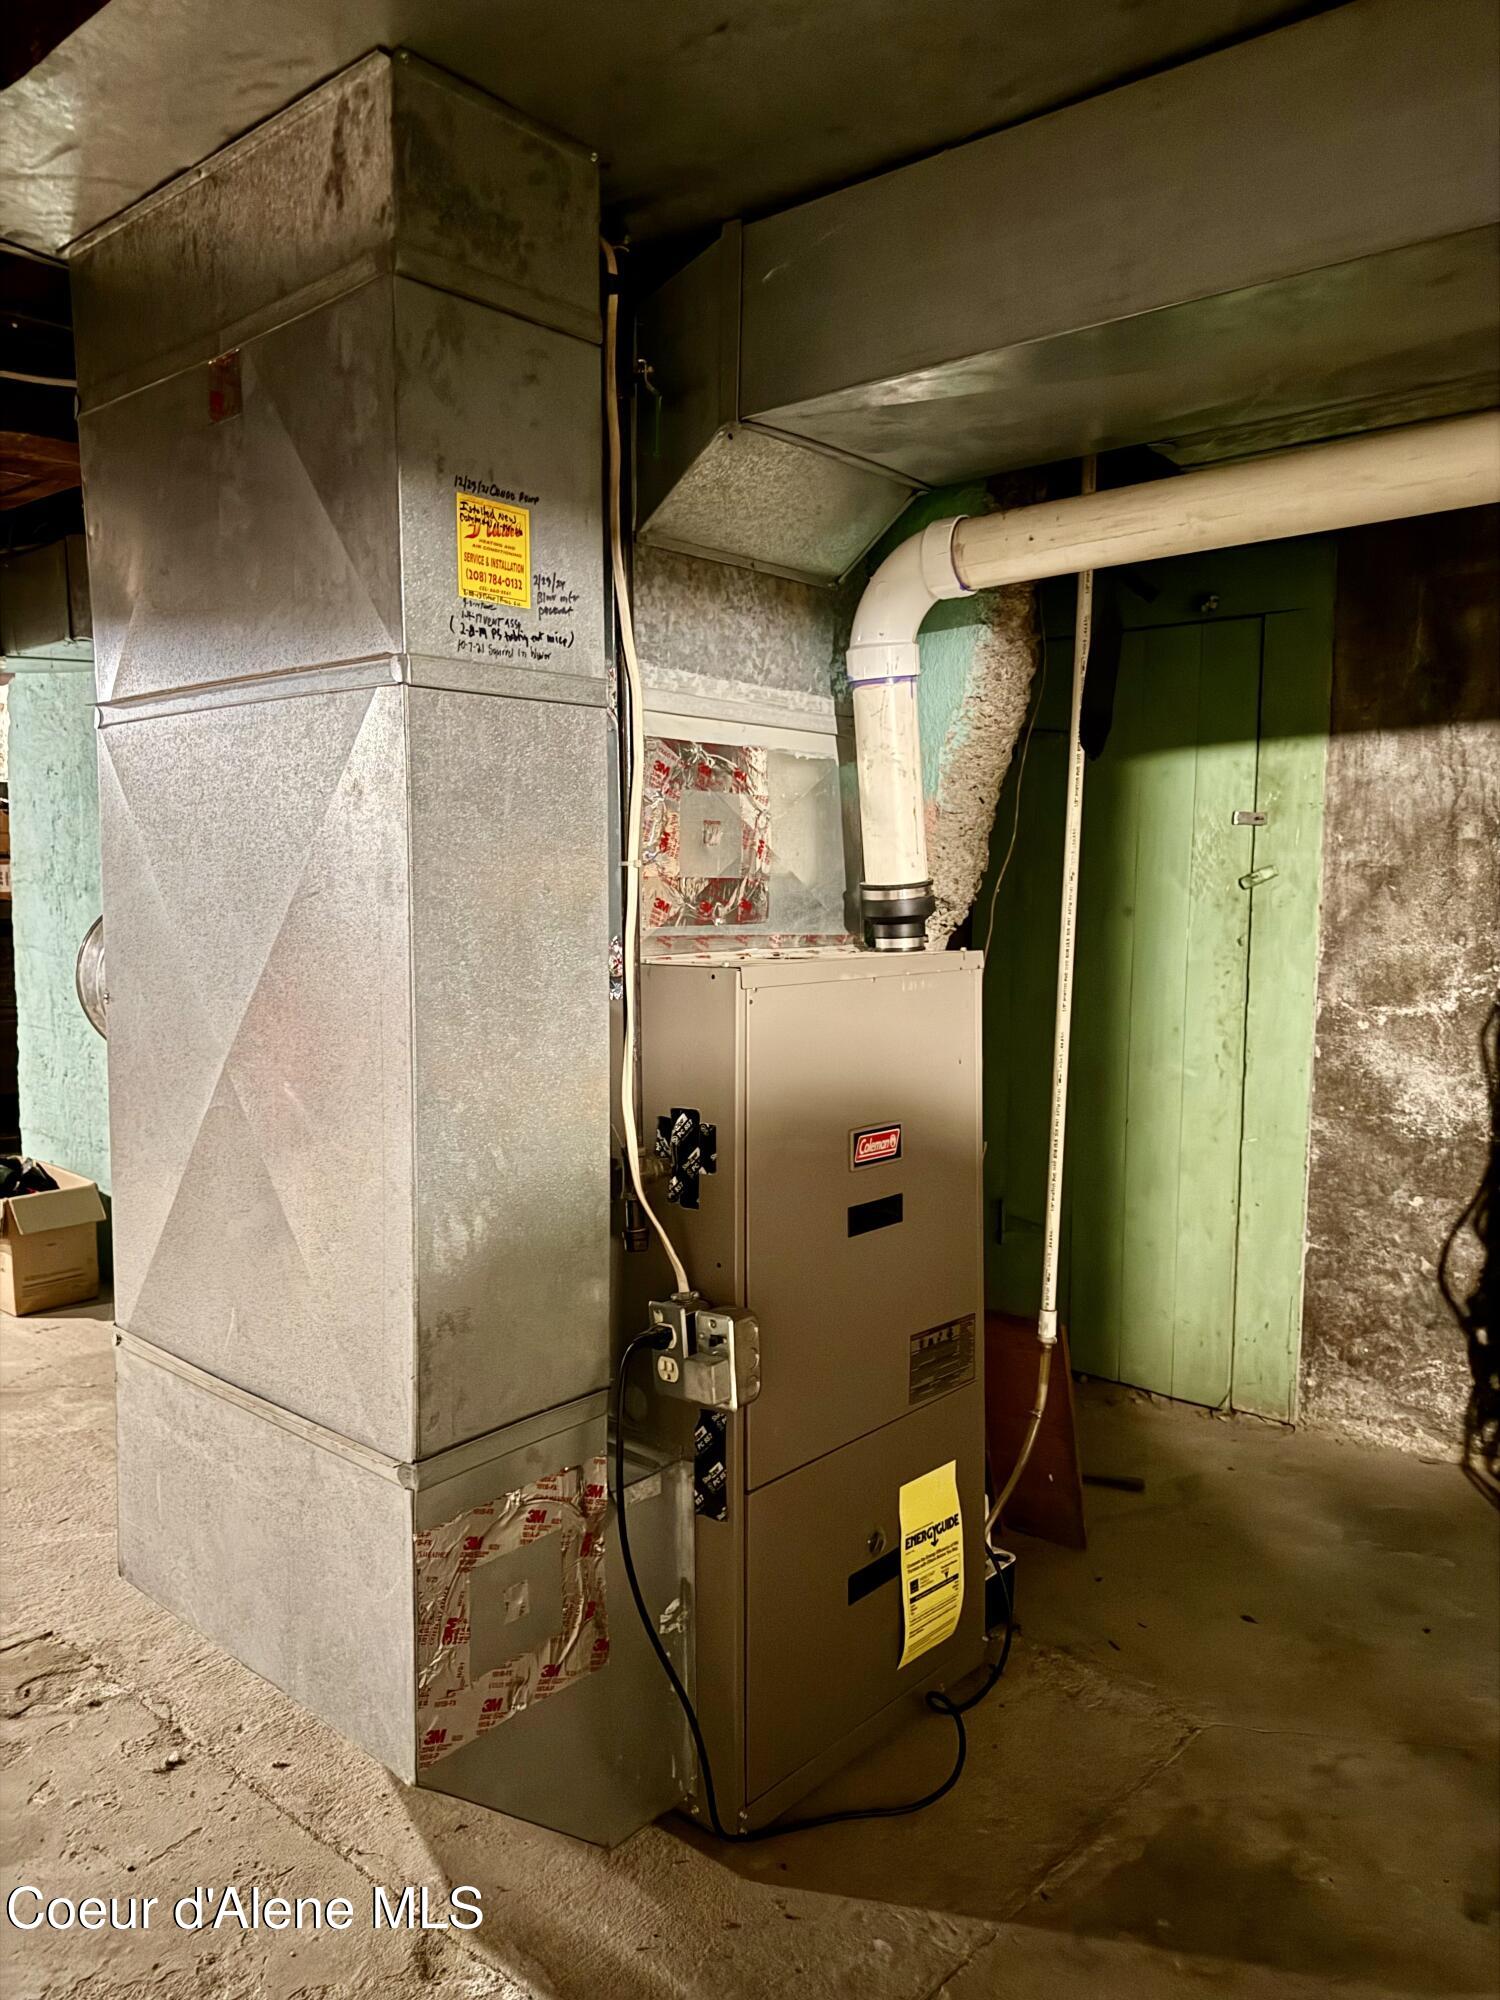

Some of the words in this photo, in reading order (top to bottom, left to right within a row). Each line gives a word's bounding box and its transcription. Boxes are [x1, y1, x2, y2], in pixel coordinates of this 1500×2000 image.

[463, 551, 485, 567] SERVICE
[490, 557, 525, 575] INSTALLATION
[465, 568, 487, 581] (208)
[488, 571, 523, 591] 784-0132
[653, 898, 670, 913] 3M
[860, 1137, 890, 1155] Coleman
[586, 1484, 604, 1498] 3M
[526, 1510, 547, 1524] 3M
[463, 1536, 485, 1551] 3M
[541, 1664, 561, 1678] 3M
[481, 1698, 503, 1713] 3M
[424, 1729, 447, 1745] 3M
